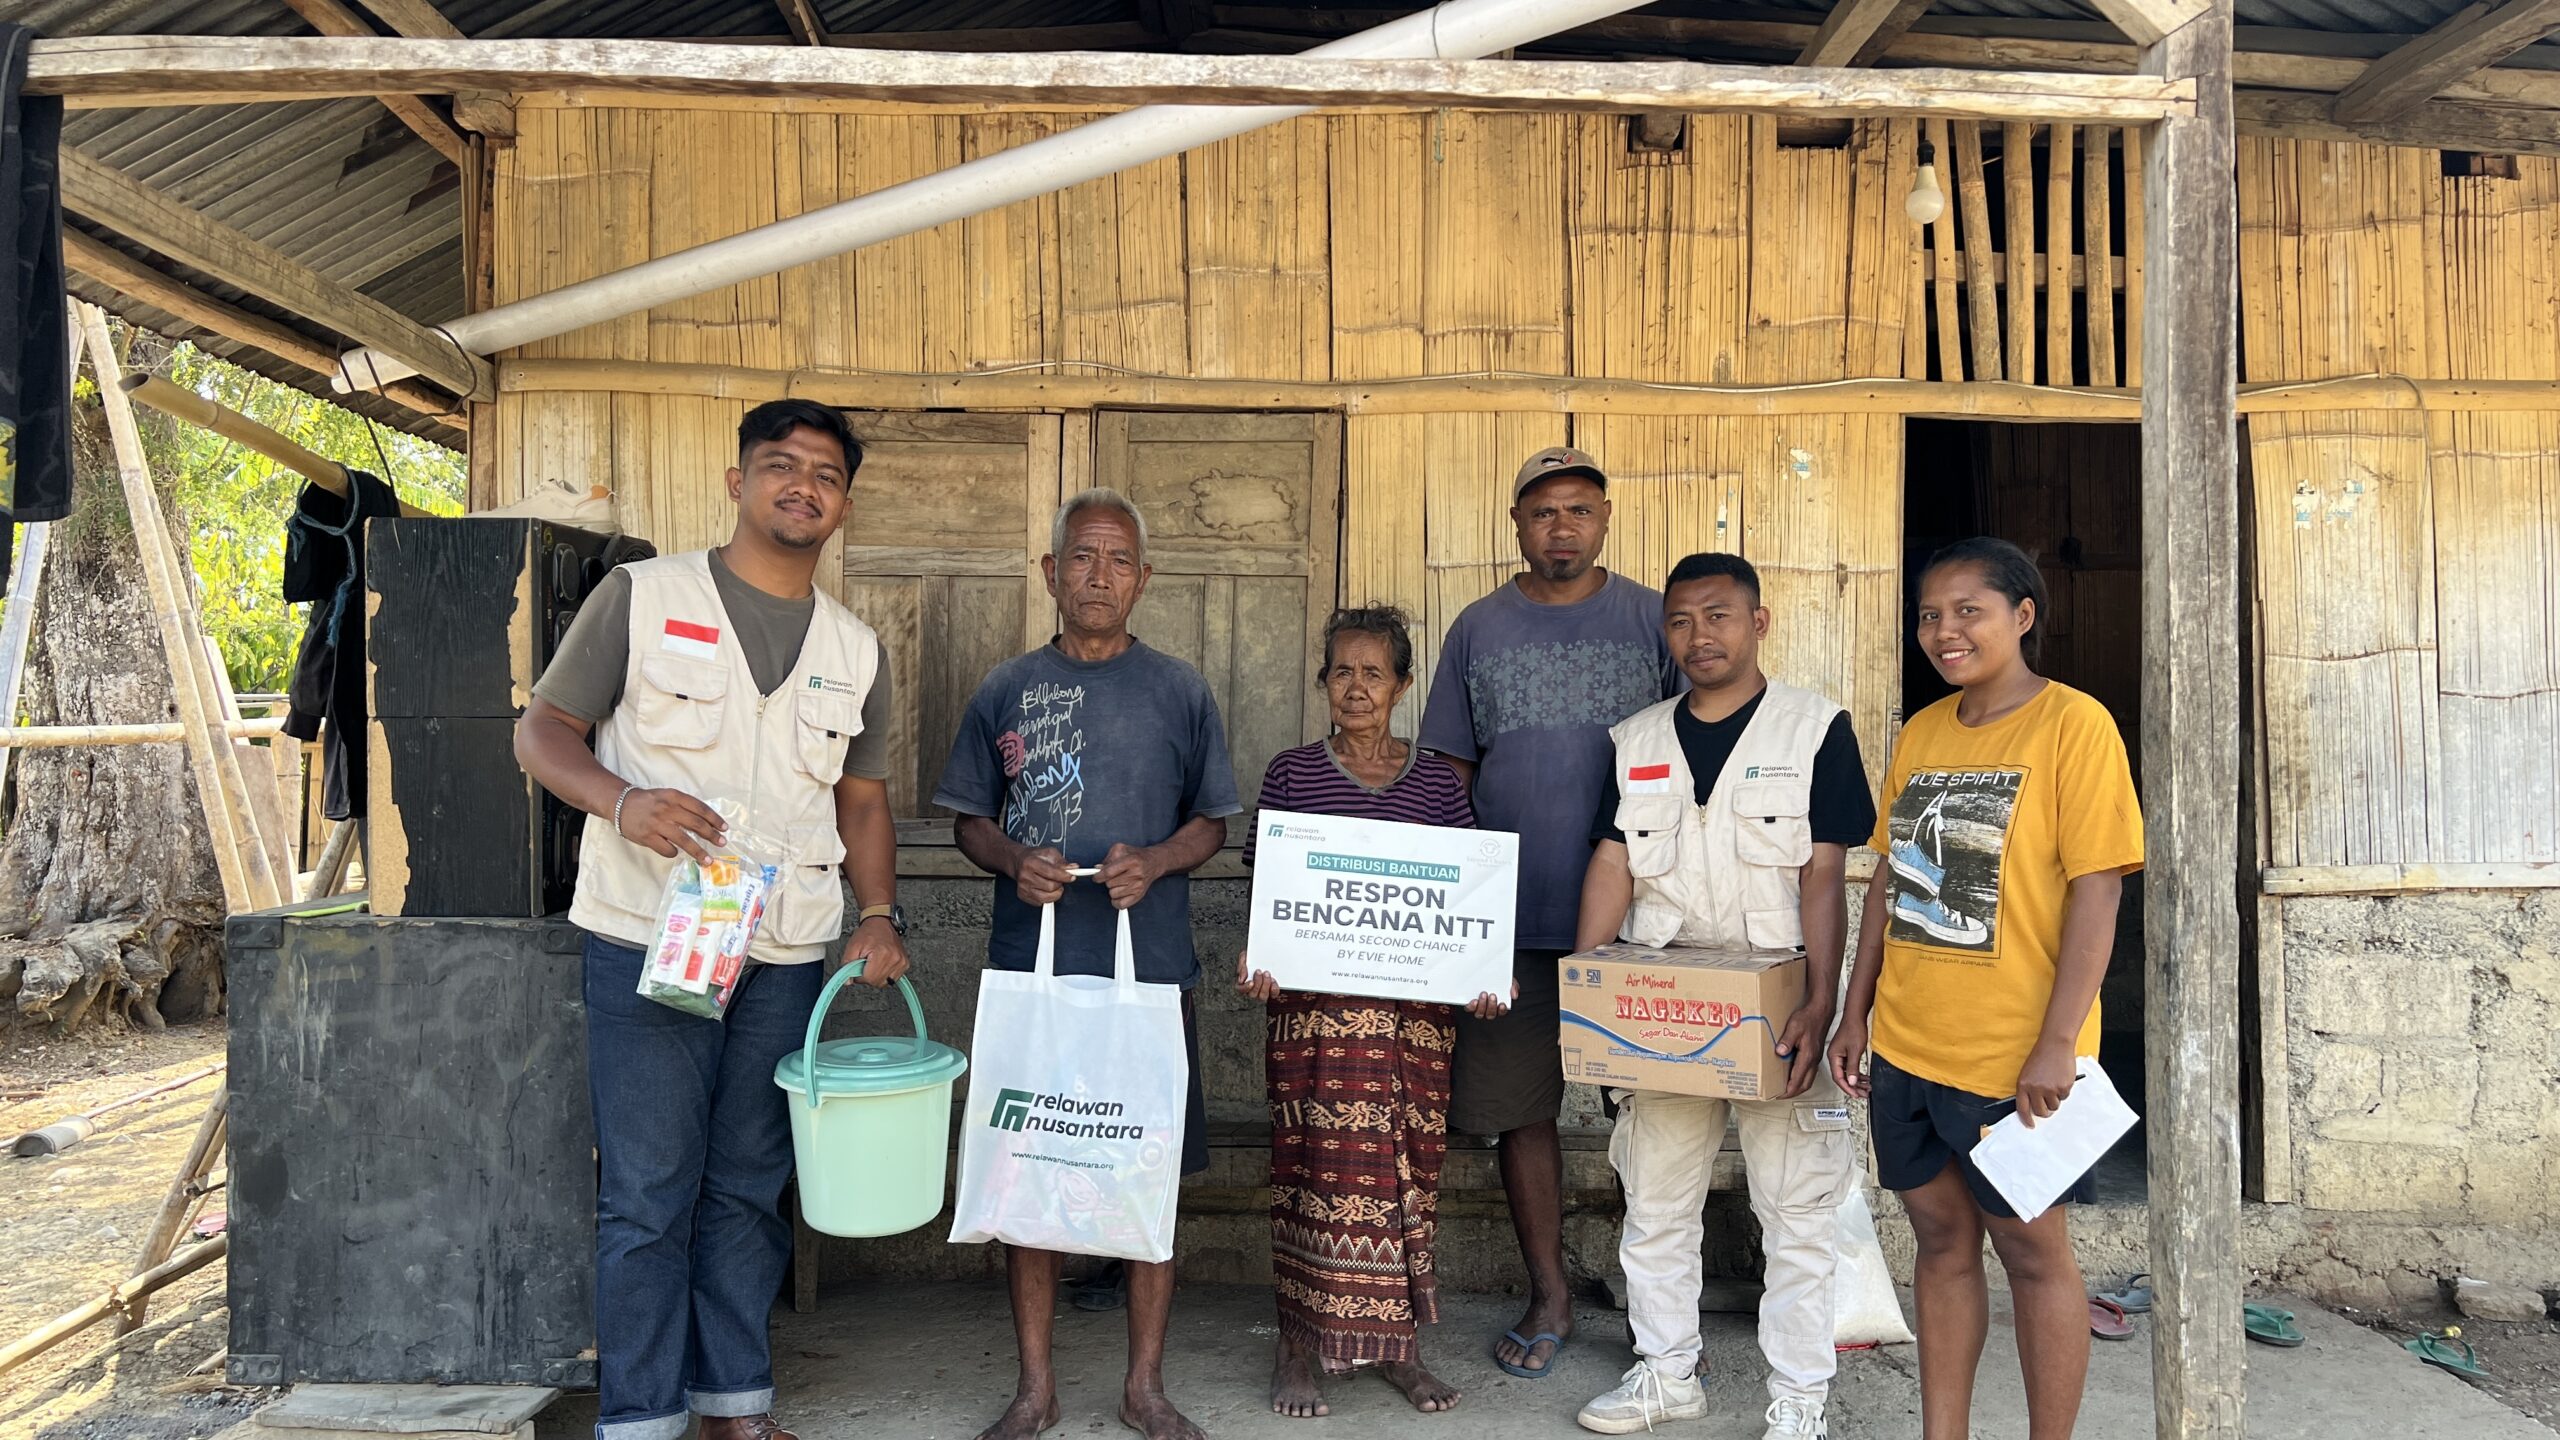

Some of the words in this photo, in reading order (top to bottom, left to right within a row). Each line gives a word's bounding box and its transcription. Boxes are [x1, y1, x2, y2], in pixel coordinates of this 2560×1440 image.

[823, 678, 853, 688] relawan
[1284, 833, 1326, 842] nusantara
[1286, 826, 1319, 834] relawan
[1308, 854, 1386, 872] DISTRIBUSI
[1389, 862, 1459, 880] BANTUAN
[1325, 878, 1446, 909] RESPON
[1272, 899, 1424, 934] BENCANA
[1434, 914, 1495, 939] NTT
[1294, 928, 1355, 944] BERSAMA
[1358, 934, 1410, 949] SECOND
[1413, 939, 1467, 954] CHANCE
[1337, 949, 1354, 960] BY
[1357, 951, 1385, 963] EVIE
[1388, 954, 1426, 966] HOME
[1331, 970, 1428, 985] www.relawannusantara.org
[1625, 973, 1640, 986] Air
[1642, 975, 1676, 990] Mineral
[1615, 994, 1741, 1028] NAGEKEO
[1663, 1027, 1678, 1038] Dan
[1033, 1092, 1124, 1117] relawan
[1025, 1115, 1143, 1139] nusantara
[1011, 1151, 1114, 1170] www.relawannusantara.org
